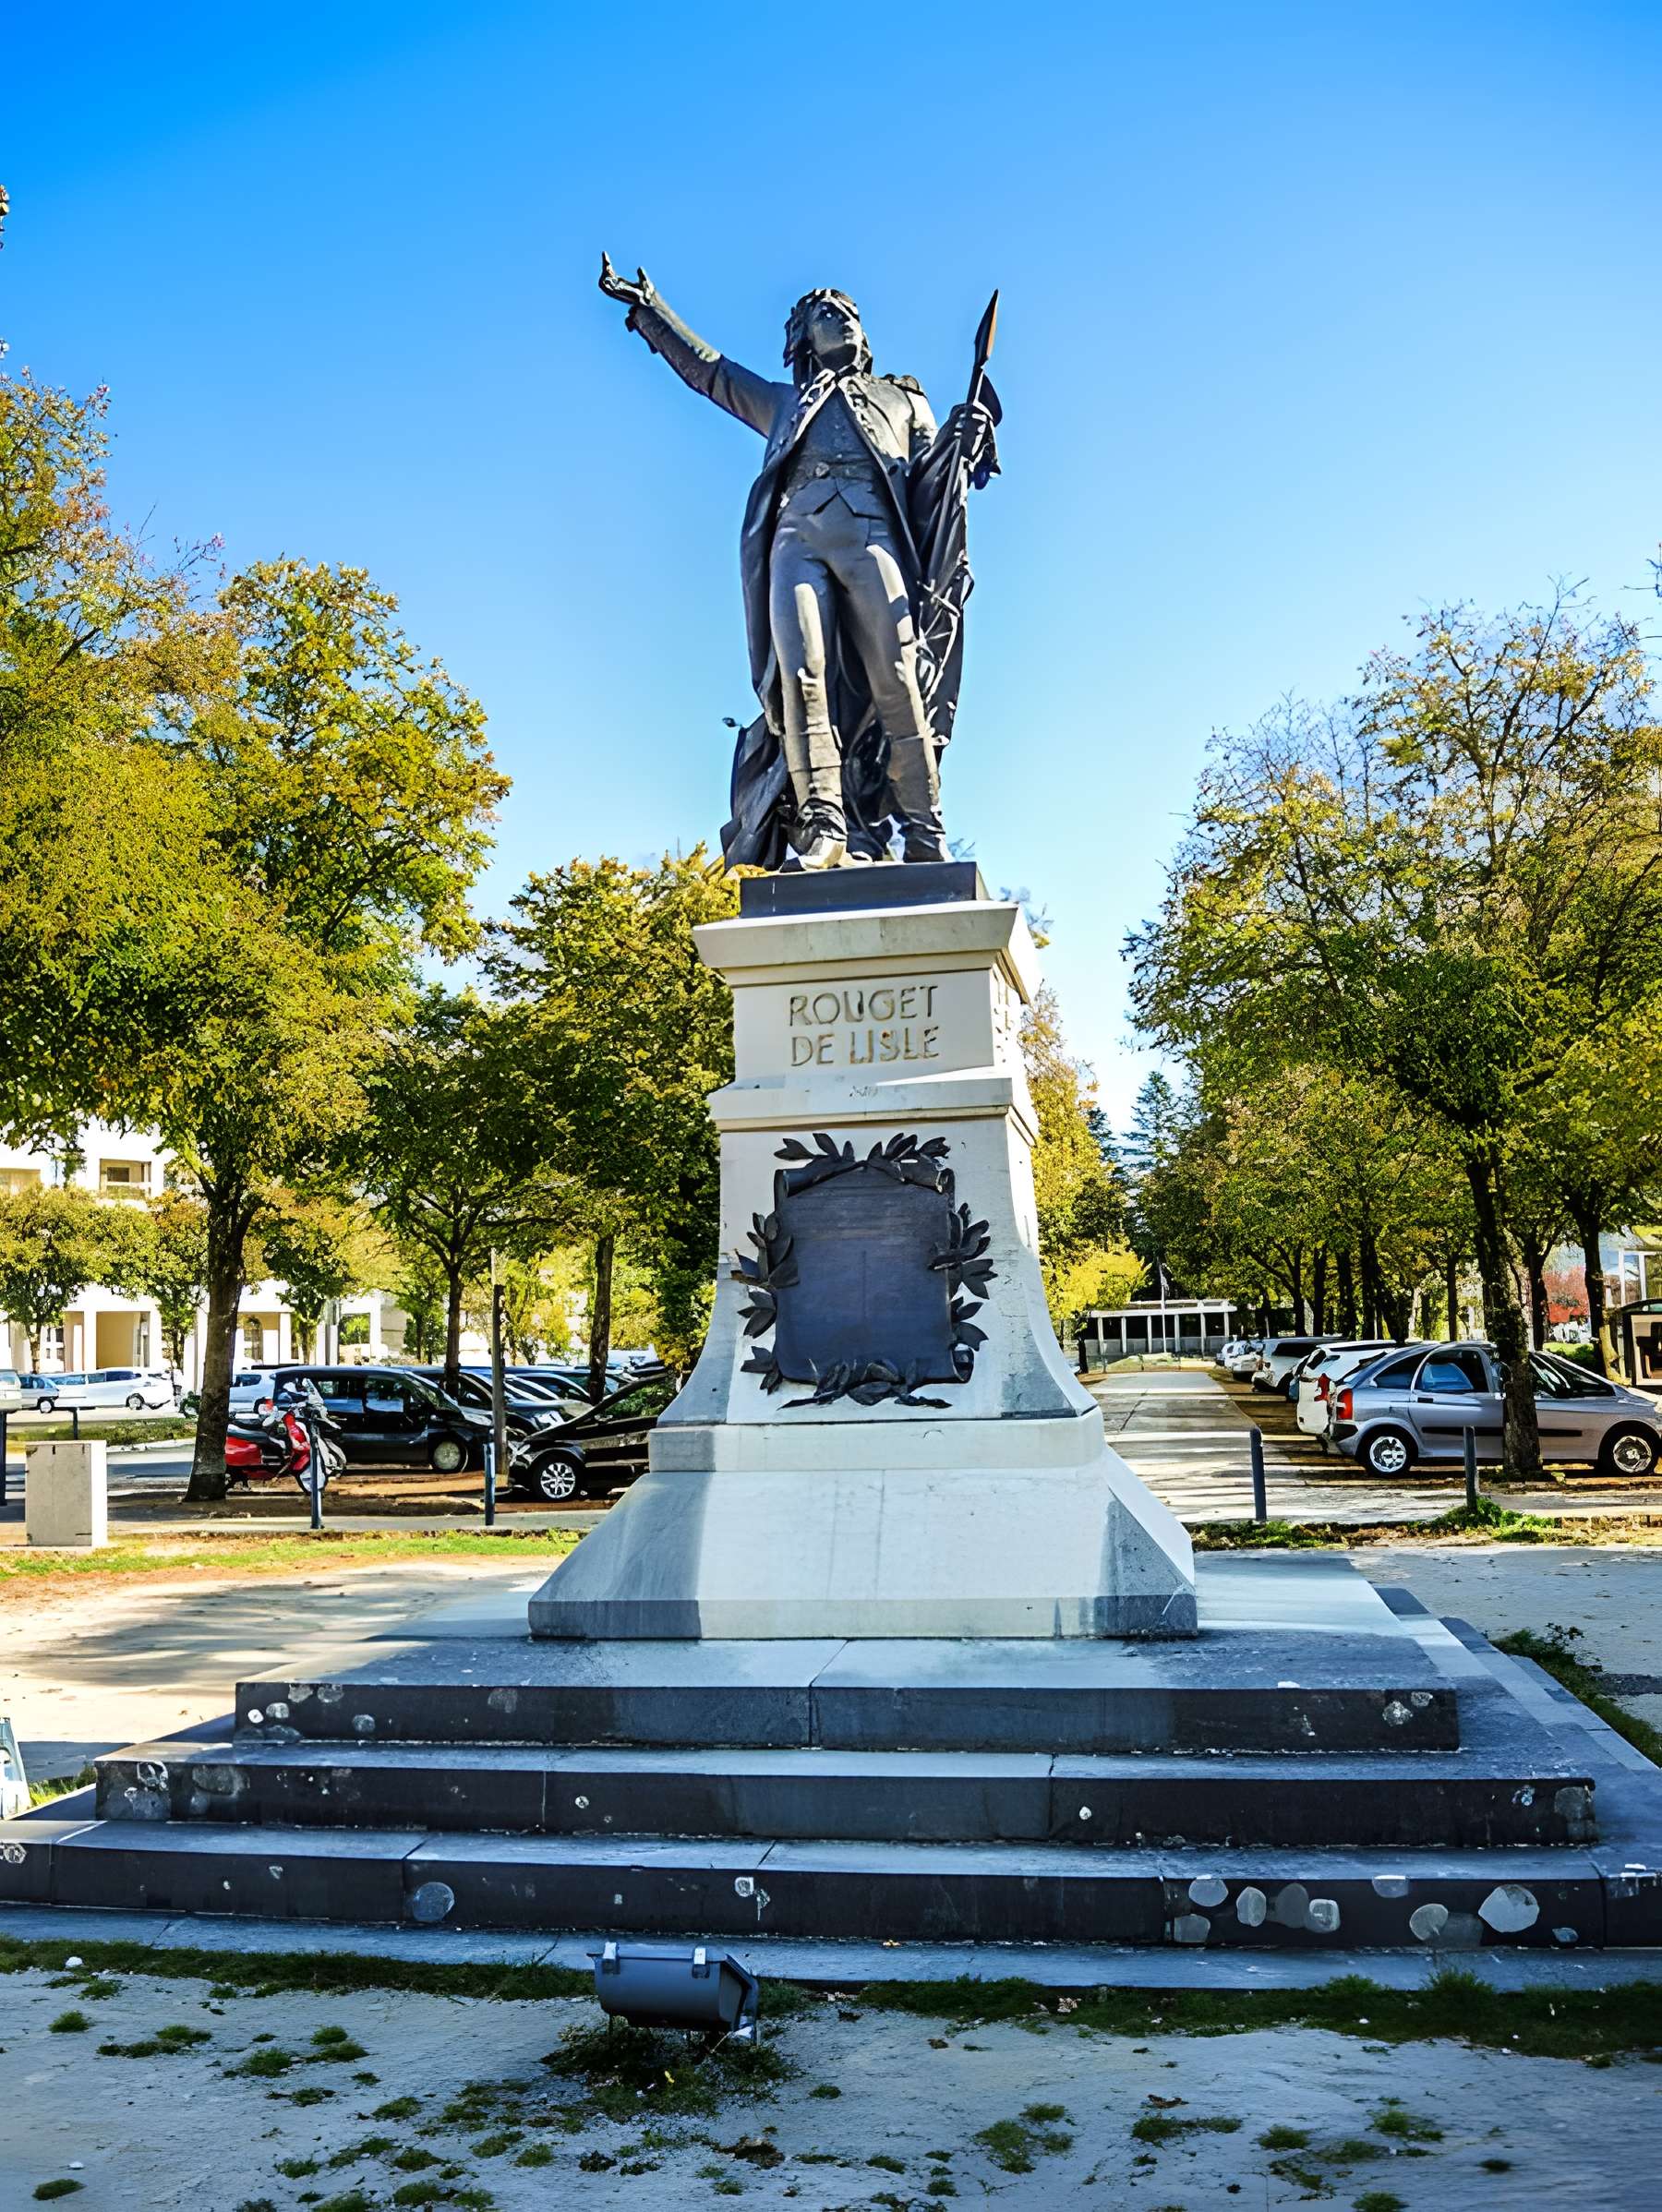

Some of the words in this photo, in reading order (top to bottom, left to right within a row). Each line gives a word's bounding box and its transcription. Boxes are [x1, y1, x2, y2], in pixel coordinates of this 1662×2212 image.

[789, 985, 938, 1027] ROUGET
[790, 1033, 835, 1067] DE
[849, 1026, 939, 1064] LISLE
